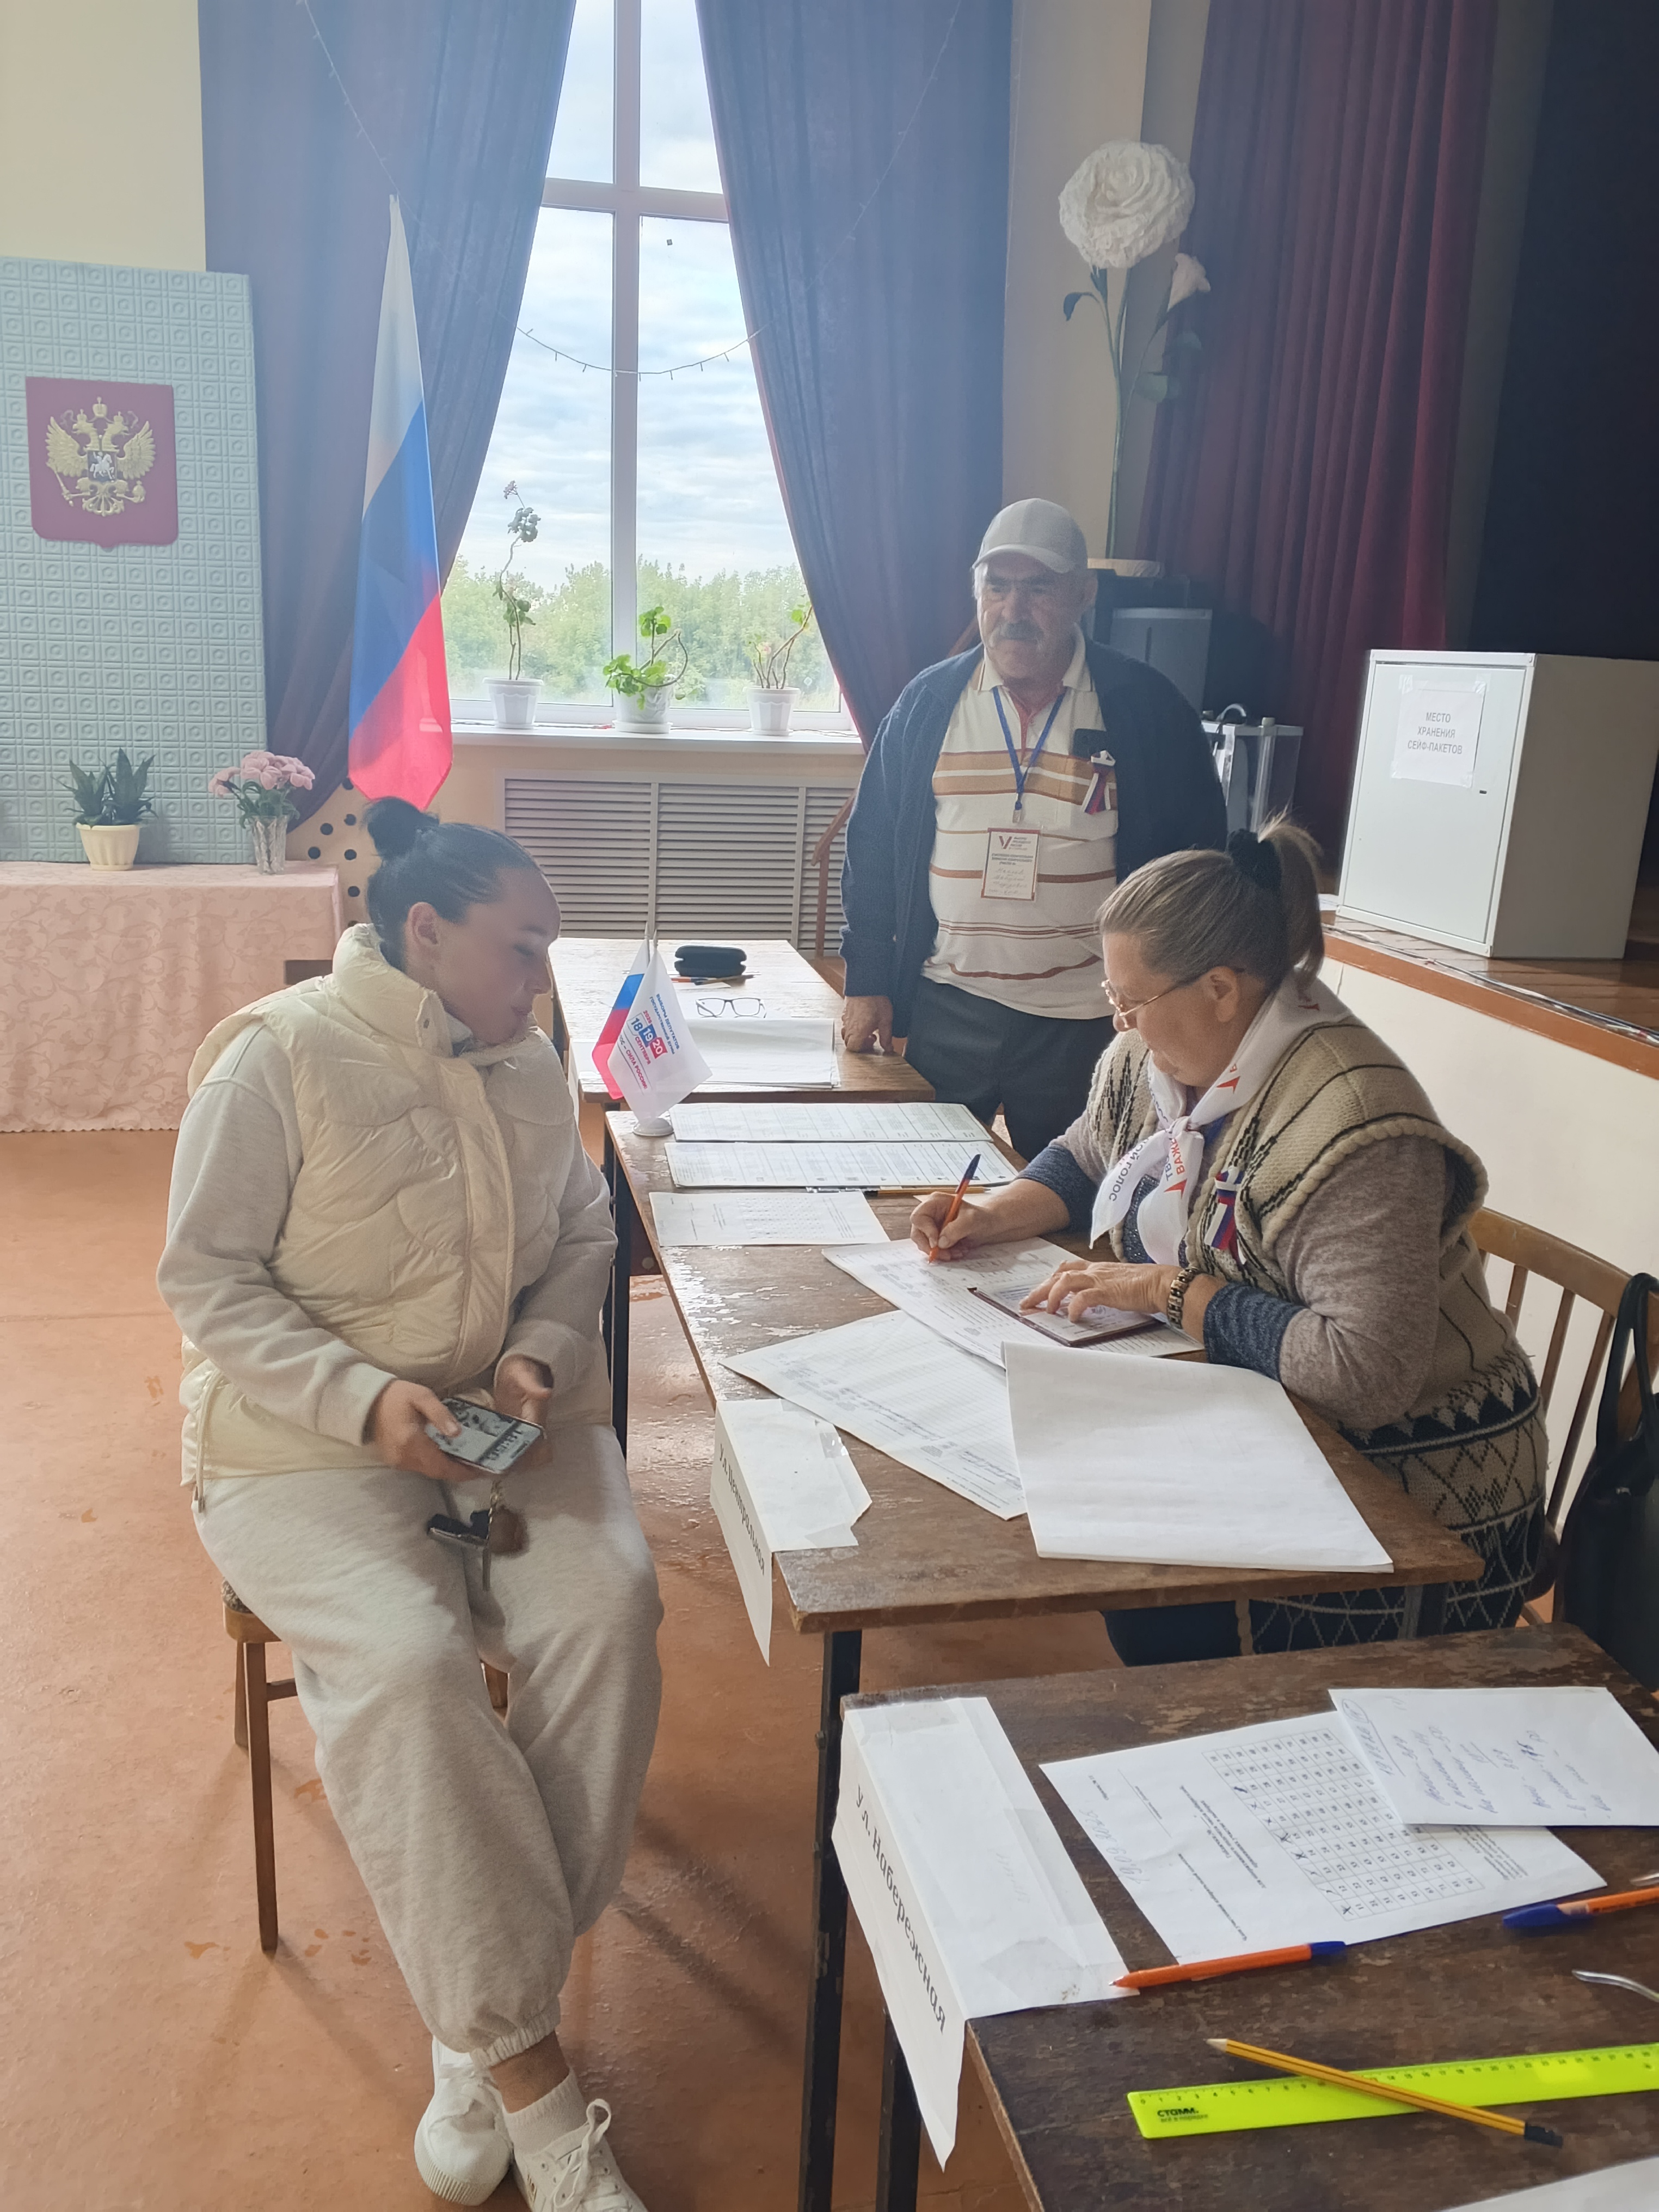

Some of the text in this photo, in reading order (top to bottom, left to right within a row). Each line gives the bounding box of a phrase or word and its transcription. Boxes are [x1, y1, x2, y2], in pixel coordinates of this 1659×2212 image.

[1417, 726, 1455, 739] ХРАНЕНИЯ
[1425, 712, 1451, 723] МЕСТО
[1408, 739, 1463, 754] СЕЙФ-ПАКЕТОВ
[649, 996, 669, 1041] ГОСУДАРСТВЕННОЙ
[656, 993, 680, 1049] ВЫБОРЫ ДЕПУТАТОВ
[630, 1017, 663, 1055] 18 19 20
[635, 1036, 651, 1065] СЕНТЯБРЯ
[625, 1049, 636, 1066] СИЛА
[728, 1465, 765, 1576] Центральная
[871, 1827, 946, 2035] Набережная
